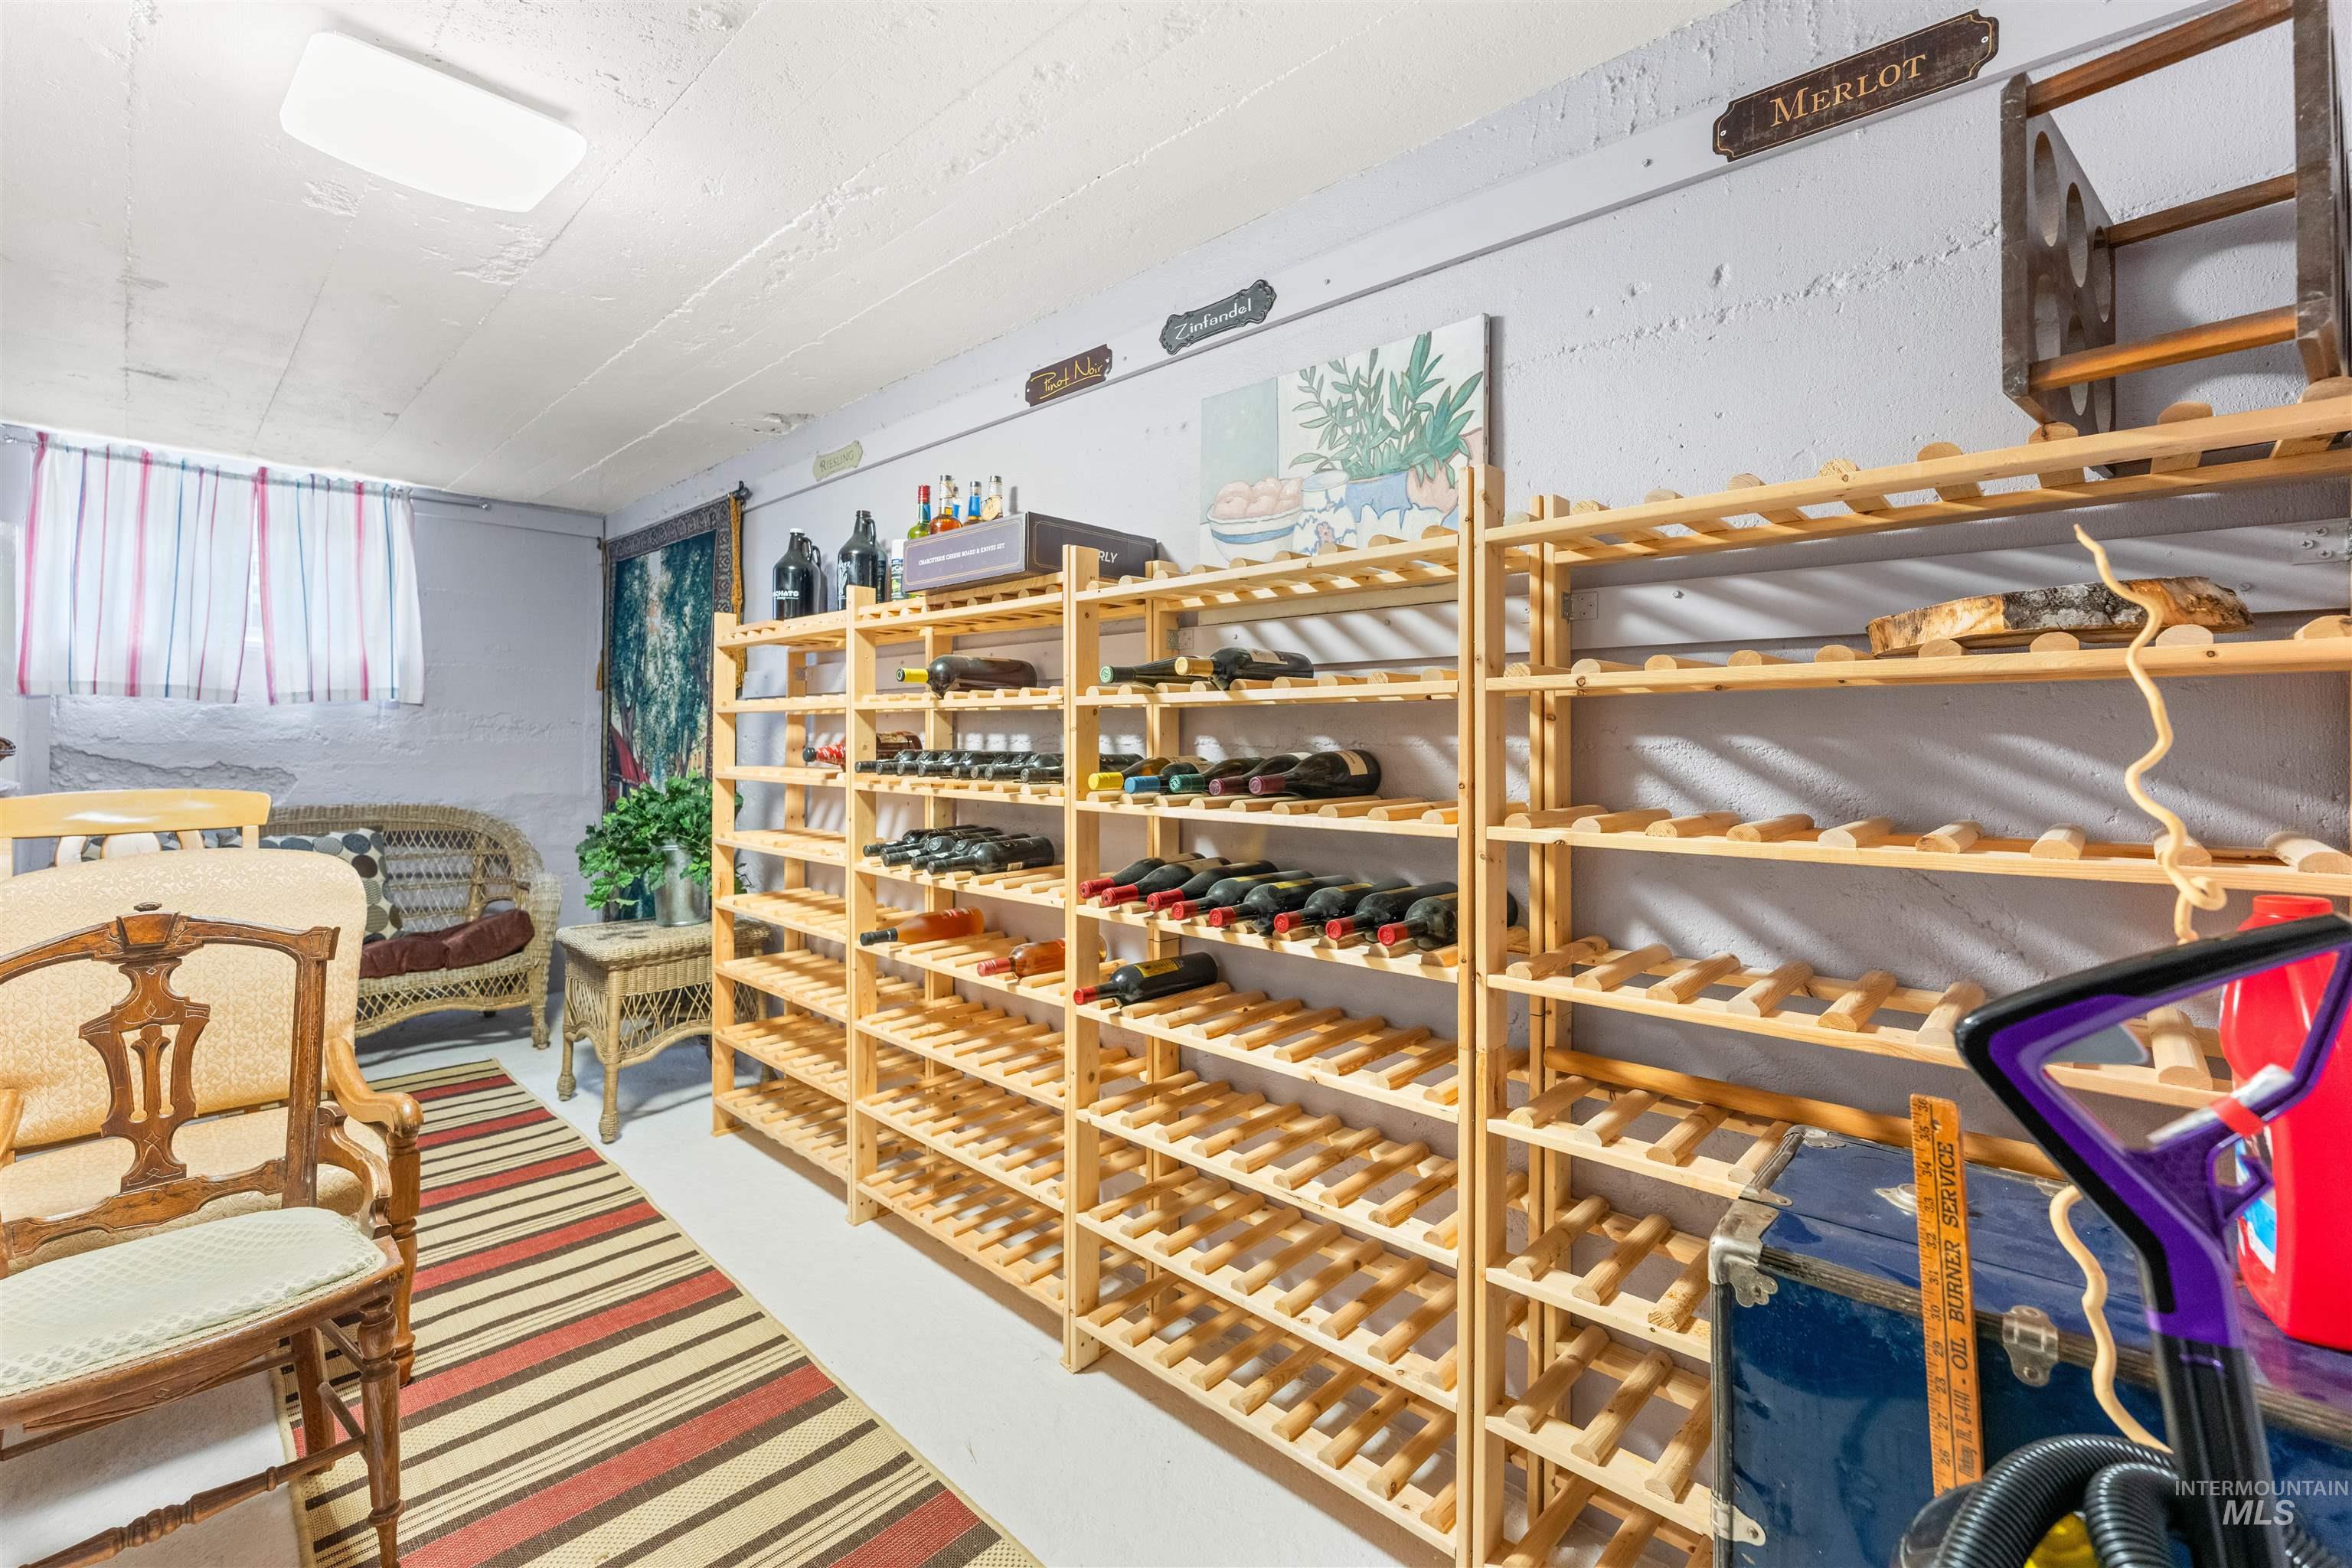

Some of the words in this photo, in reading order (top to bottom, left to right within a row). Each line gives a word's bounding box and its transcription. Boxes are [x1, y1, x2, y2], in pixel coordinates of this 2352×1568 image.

[1769, 53, 1926, 127] MERLOT
[1174, 297, 1252, 340] Zinfandel
[1031, 371, 1070, 392] Pinot
[1074, 357, 1103, 378] Noir
[819, 450, 854, 472] RIESLING
[918, 555, 946, 566] CHARCUTERIE
[946, 551, 962, 560] CHEESE
[961, 549, 976, 557] BOARD
[981, 544, 996, 553] KNIVES
[1099, 550, 1118, 563] RLY
[1918, 1098, 1928, 1112] 36
[1919, 1126, 1930, 1141] 35
[1922, 1161, 1932, 1176] 34
[1937, 1141, 1958, 1228] SERVICE
[1925, 1197, 1934, 1213] 33
[1926, 1233, 1936, 1250] 32
[1929, 1269, 1939, 1285] 31
[1945, 1240, 1965, 1325] BURNER
[1930, 1305, 1941, 1321] 30
[1934, 1341, 1944, 1358] 29
[1952, 1337, 1968, 1370] OIL
[1936, 1378, 1946, 1393] 28
[1938, 1415, 1949, 1430] 27
[1940, 1451, 1950, 1467] 26
